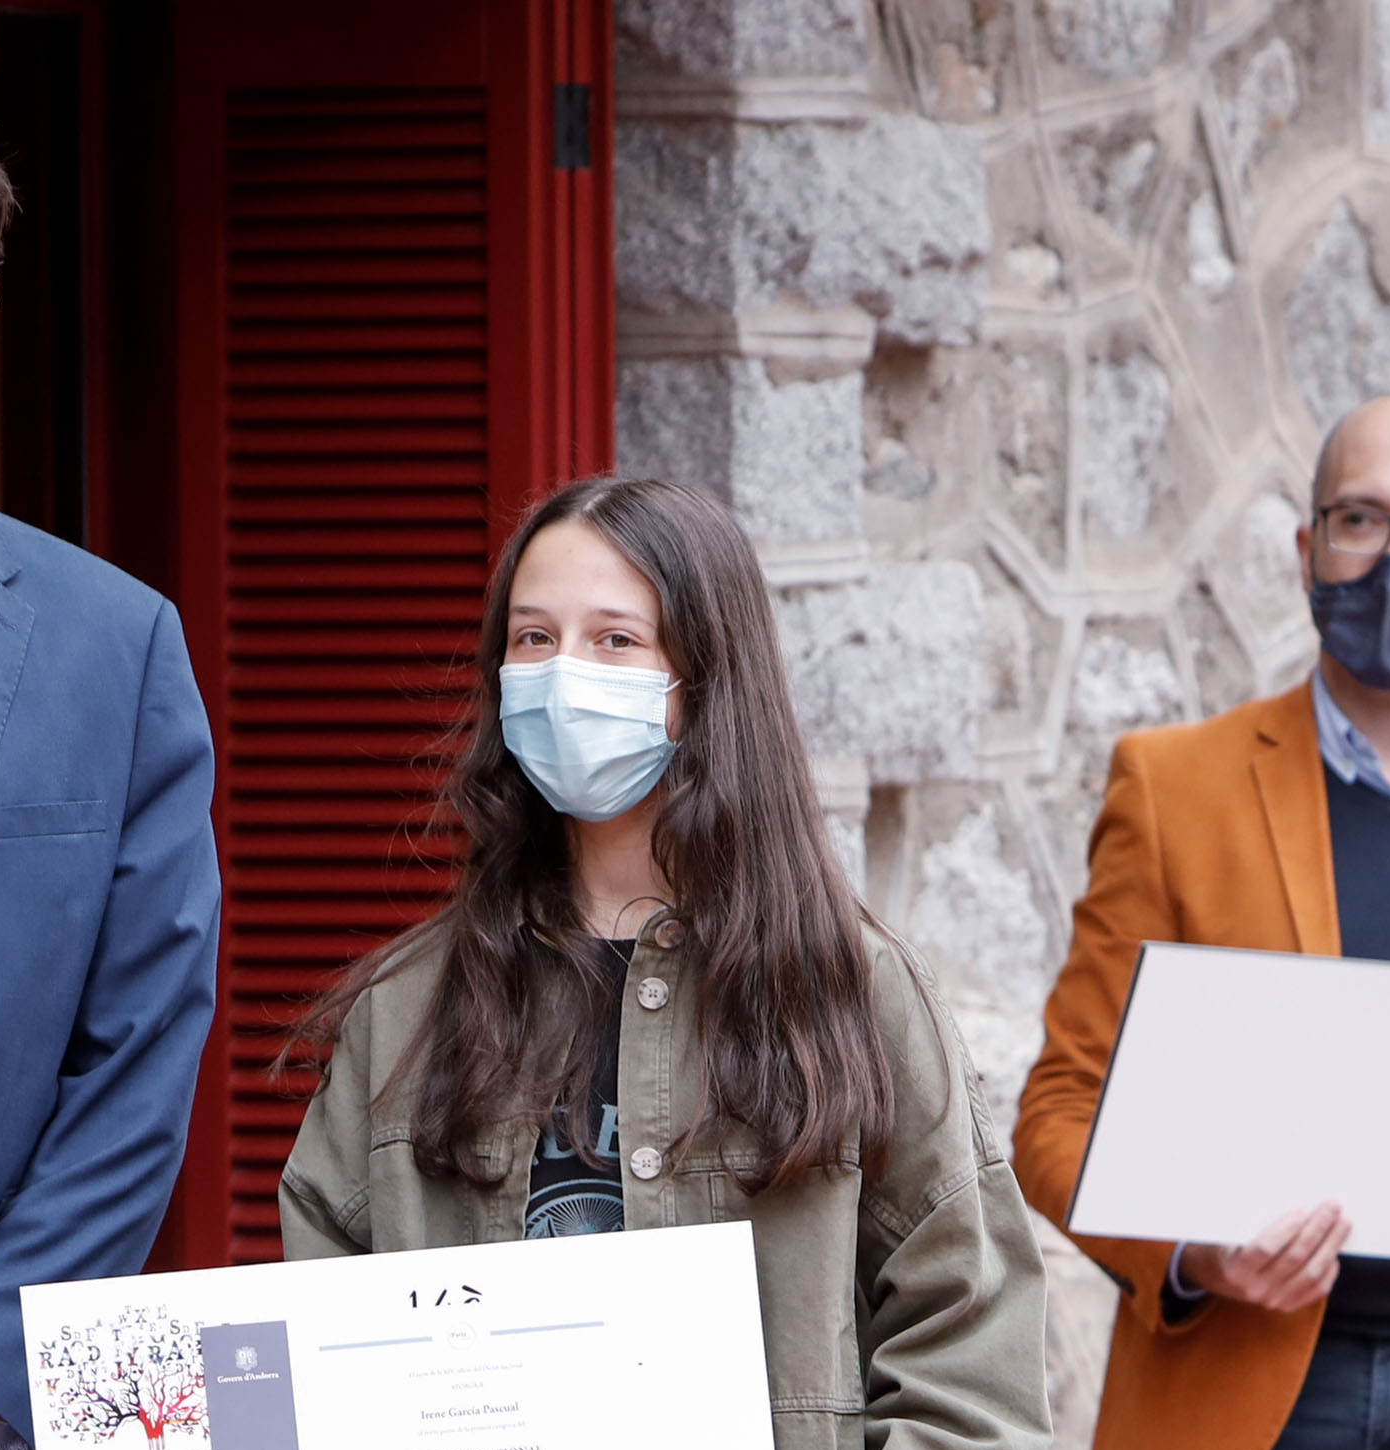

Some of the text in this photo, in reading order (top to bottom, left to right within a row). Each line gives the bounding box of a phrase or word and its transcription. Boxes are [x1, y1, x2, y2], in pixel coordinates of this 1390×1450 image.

[217, 1375, 244, 1384] Govern
[421, 1401, 519, 1420] Irene García Pascual
